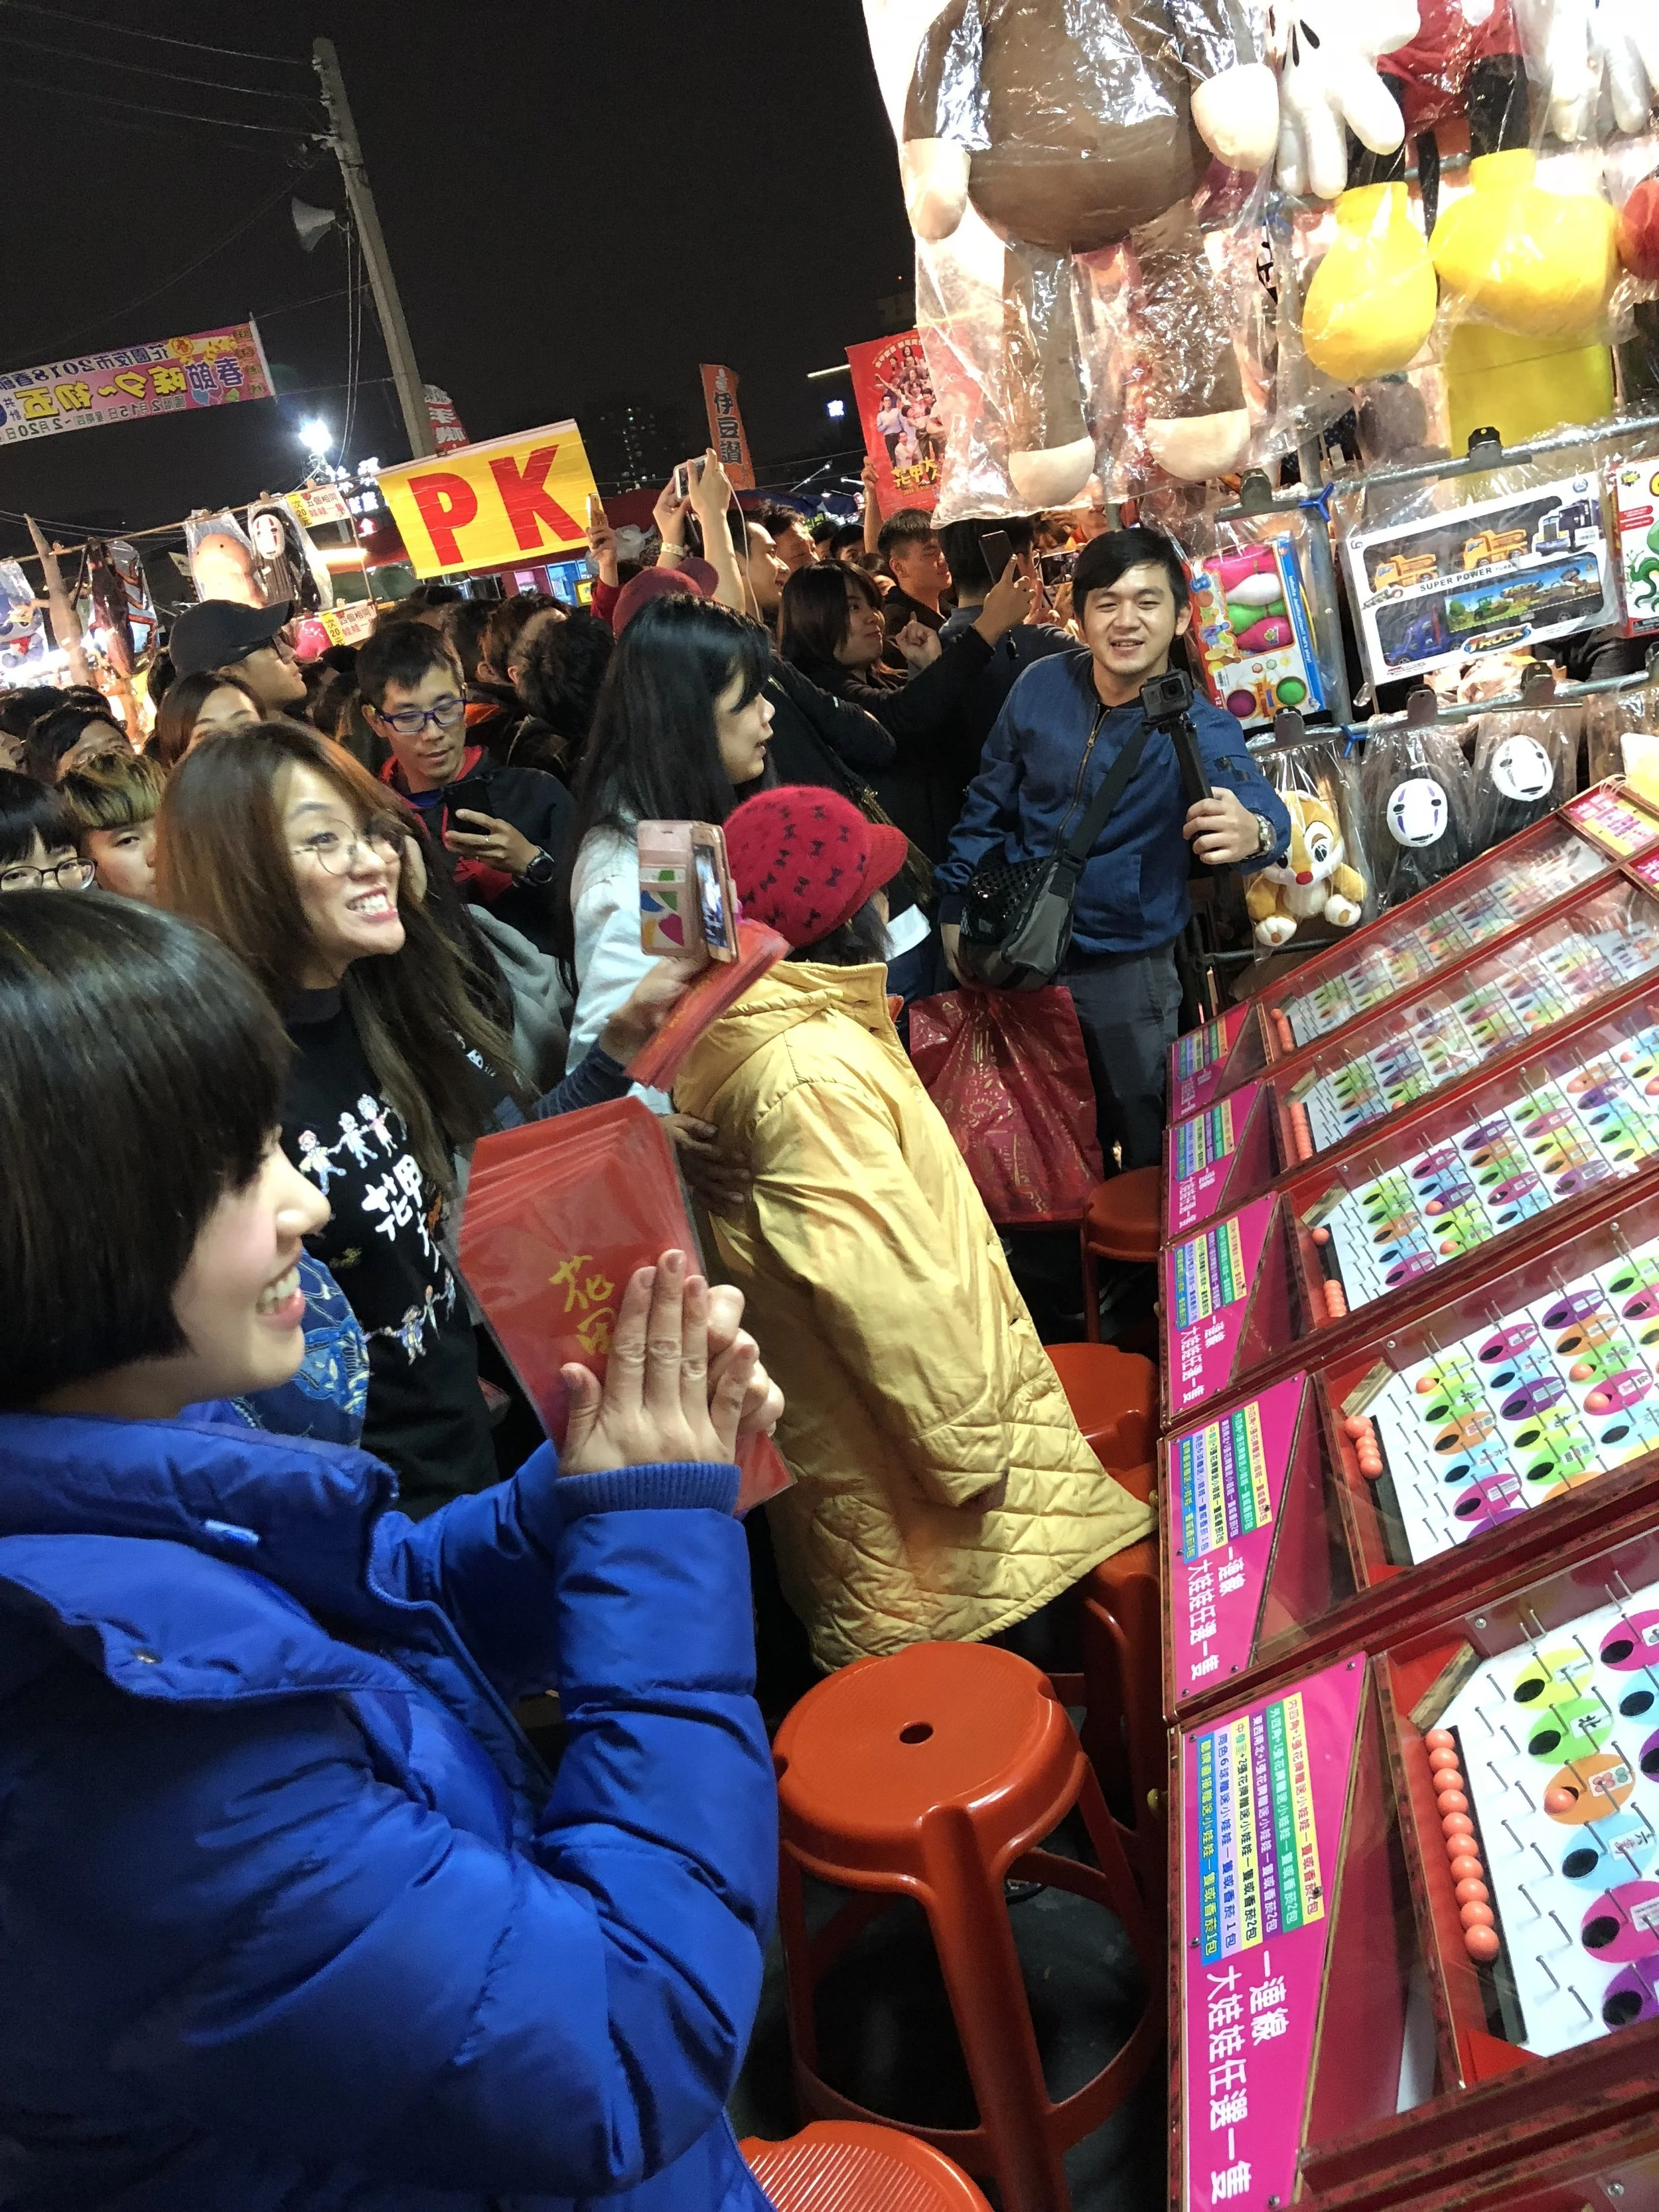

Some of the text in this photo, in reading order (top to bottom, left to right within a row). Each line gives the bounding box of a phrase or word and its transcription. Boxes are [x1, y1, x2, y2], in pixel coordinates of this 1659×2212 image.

[407, 444, 587, 567] PK
[1420, 578, 1453, 591] SUPER
[1457, 567, 1492, 582] POWER
[1468, 625, 1528, 654] TRUCK
[1217, 1546, 1246, 1597] 一連線
[1189, 1559, 1219, 1680] 大娃娃任選一隻
[1249, 1951, 1288, 2045] 一連線
[1206, 1965, 1252, 2204] 大娃娃任選一隻
